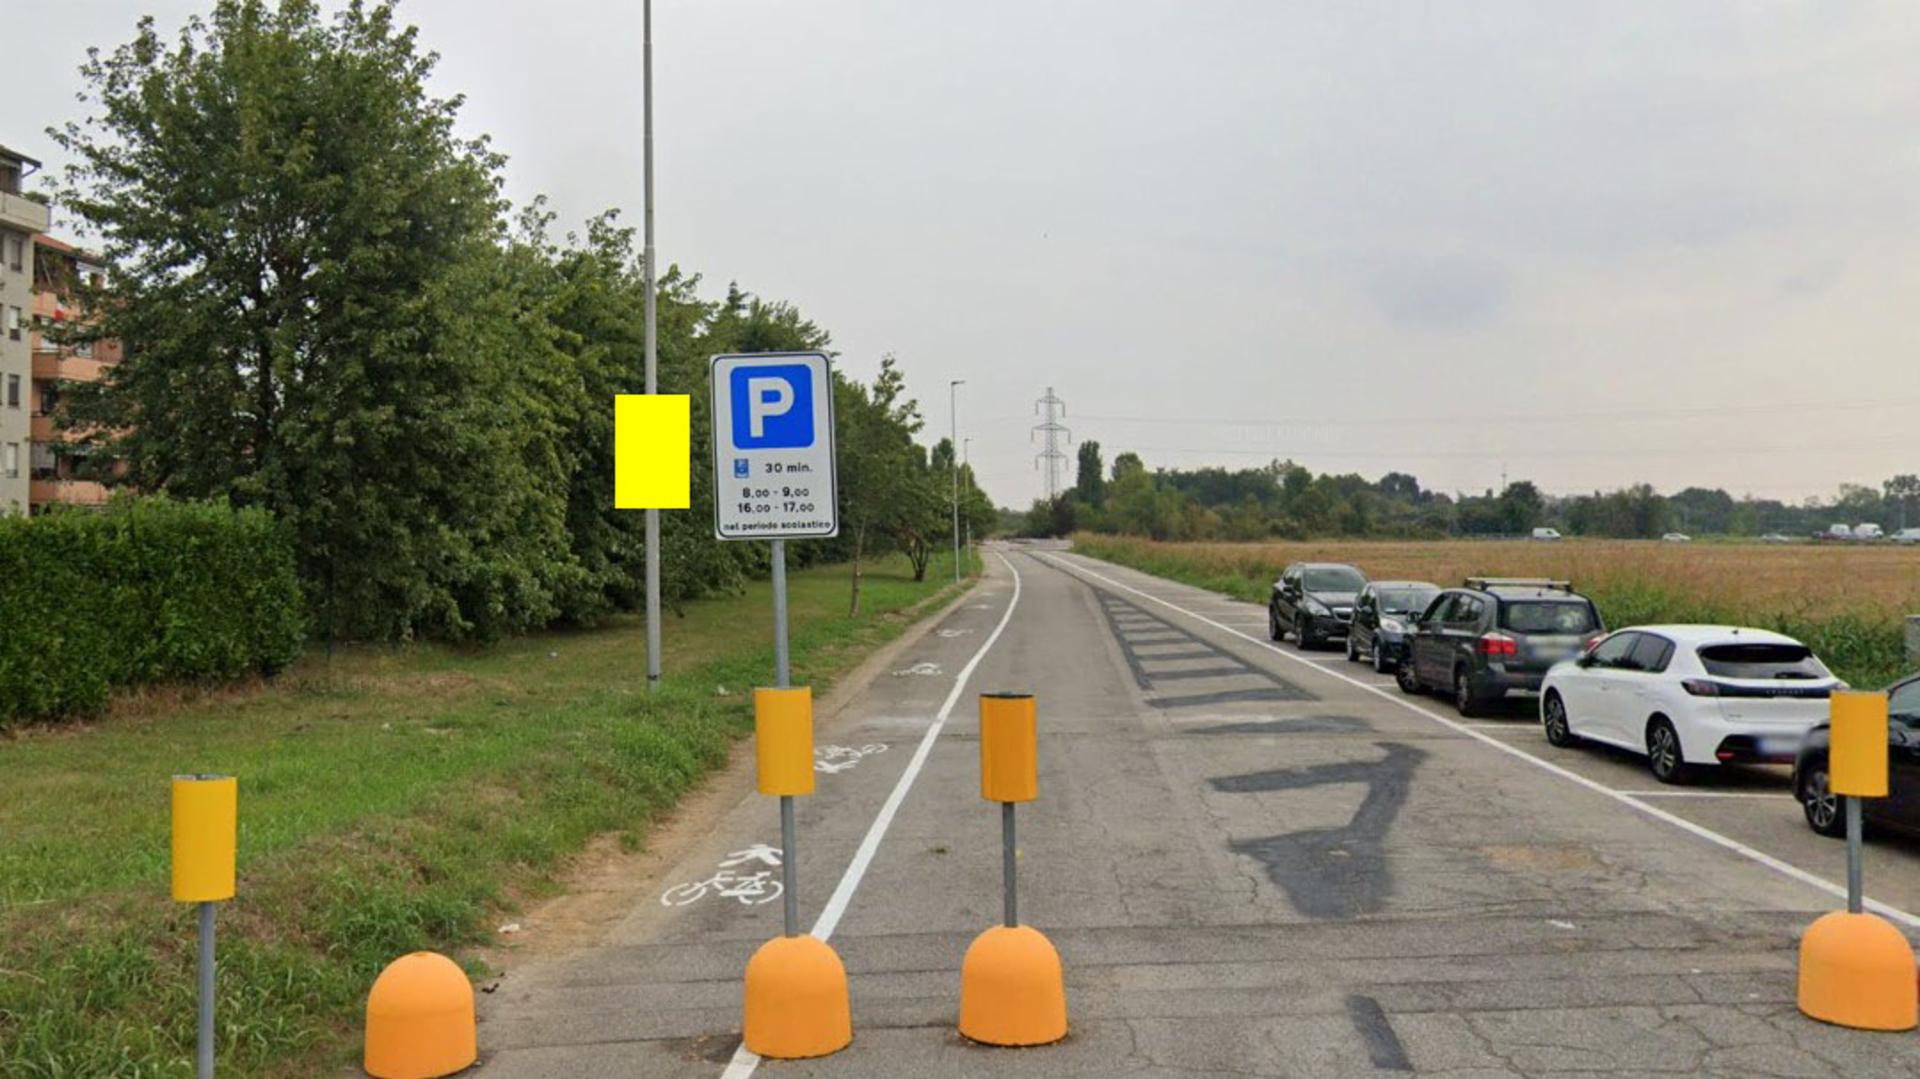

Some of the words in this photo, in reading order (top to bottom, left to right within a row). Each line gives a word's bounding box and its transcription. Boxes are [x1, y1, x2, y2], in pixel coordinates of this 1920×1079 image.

[748, 376, 795, 438] P
[765, 463, 782, 473] 30
[787, 461, 813, 473] min.
[742, 487, 769, 499] 8.00
[738, 503, 770, 514] 16.00
[723, 522, 740, 531] nel
[741, 521, 778, 532] periodo
[781, 520, 831, 530] scolastico
